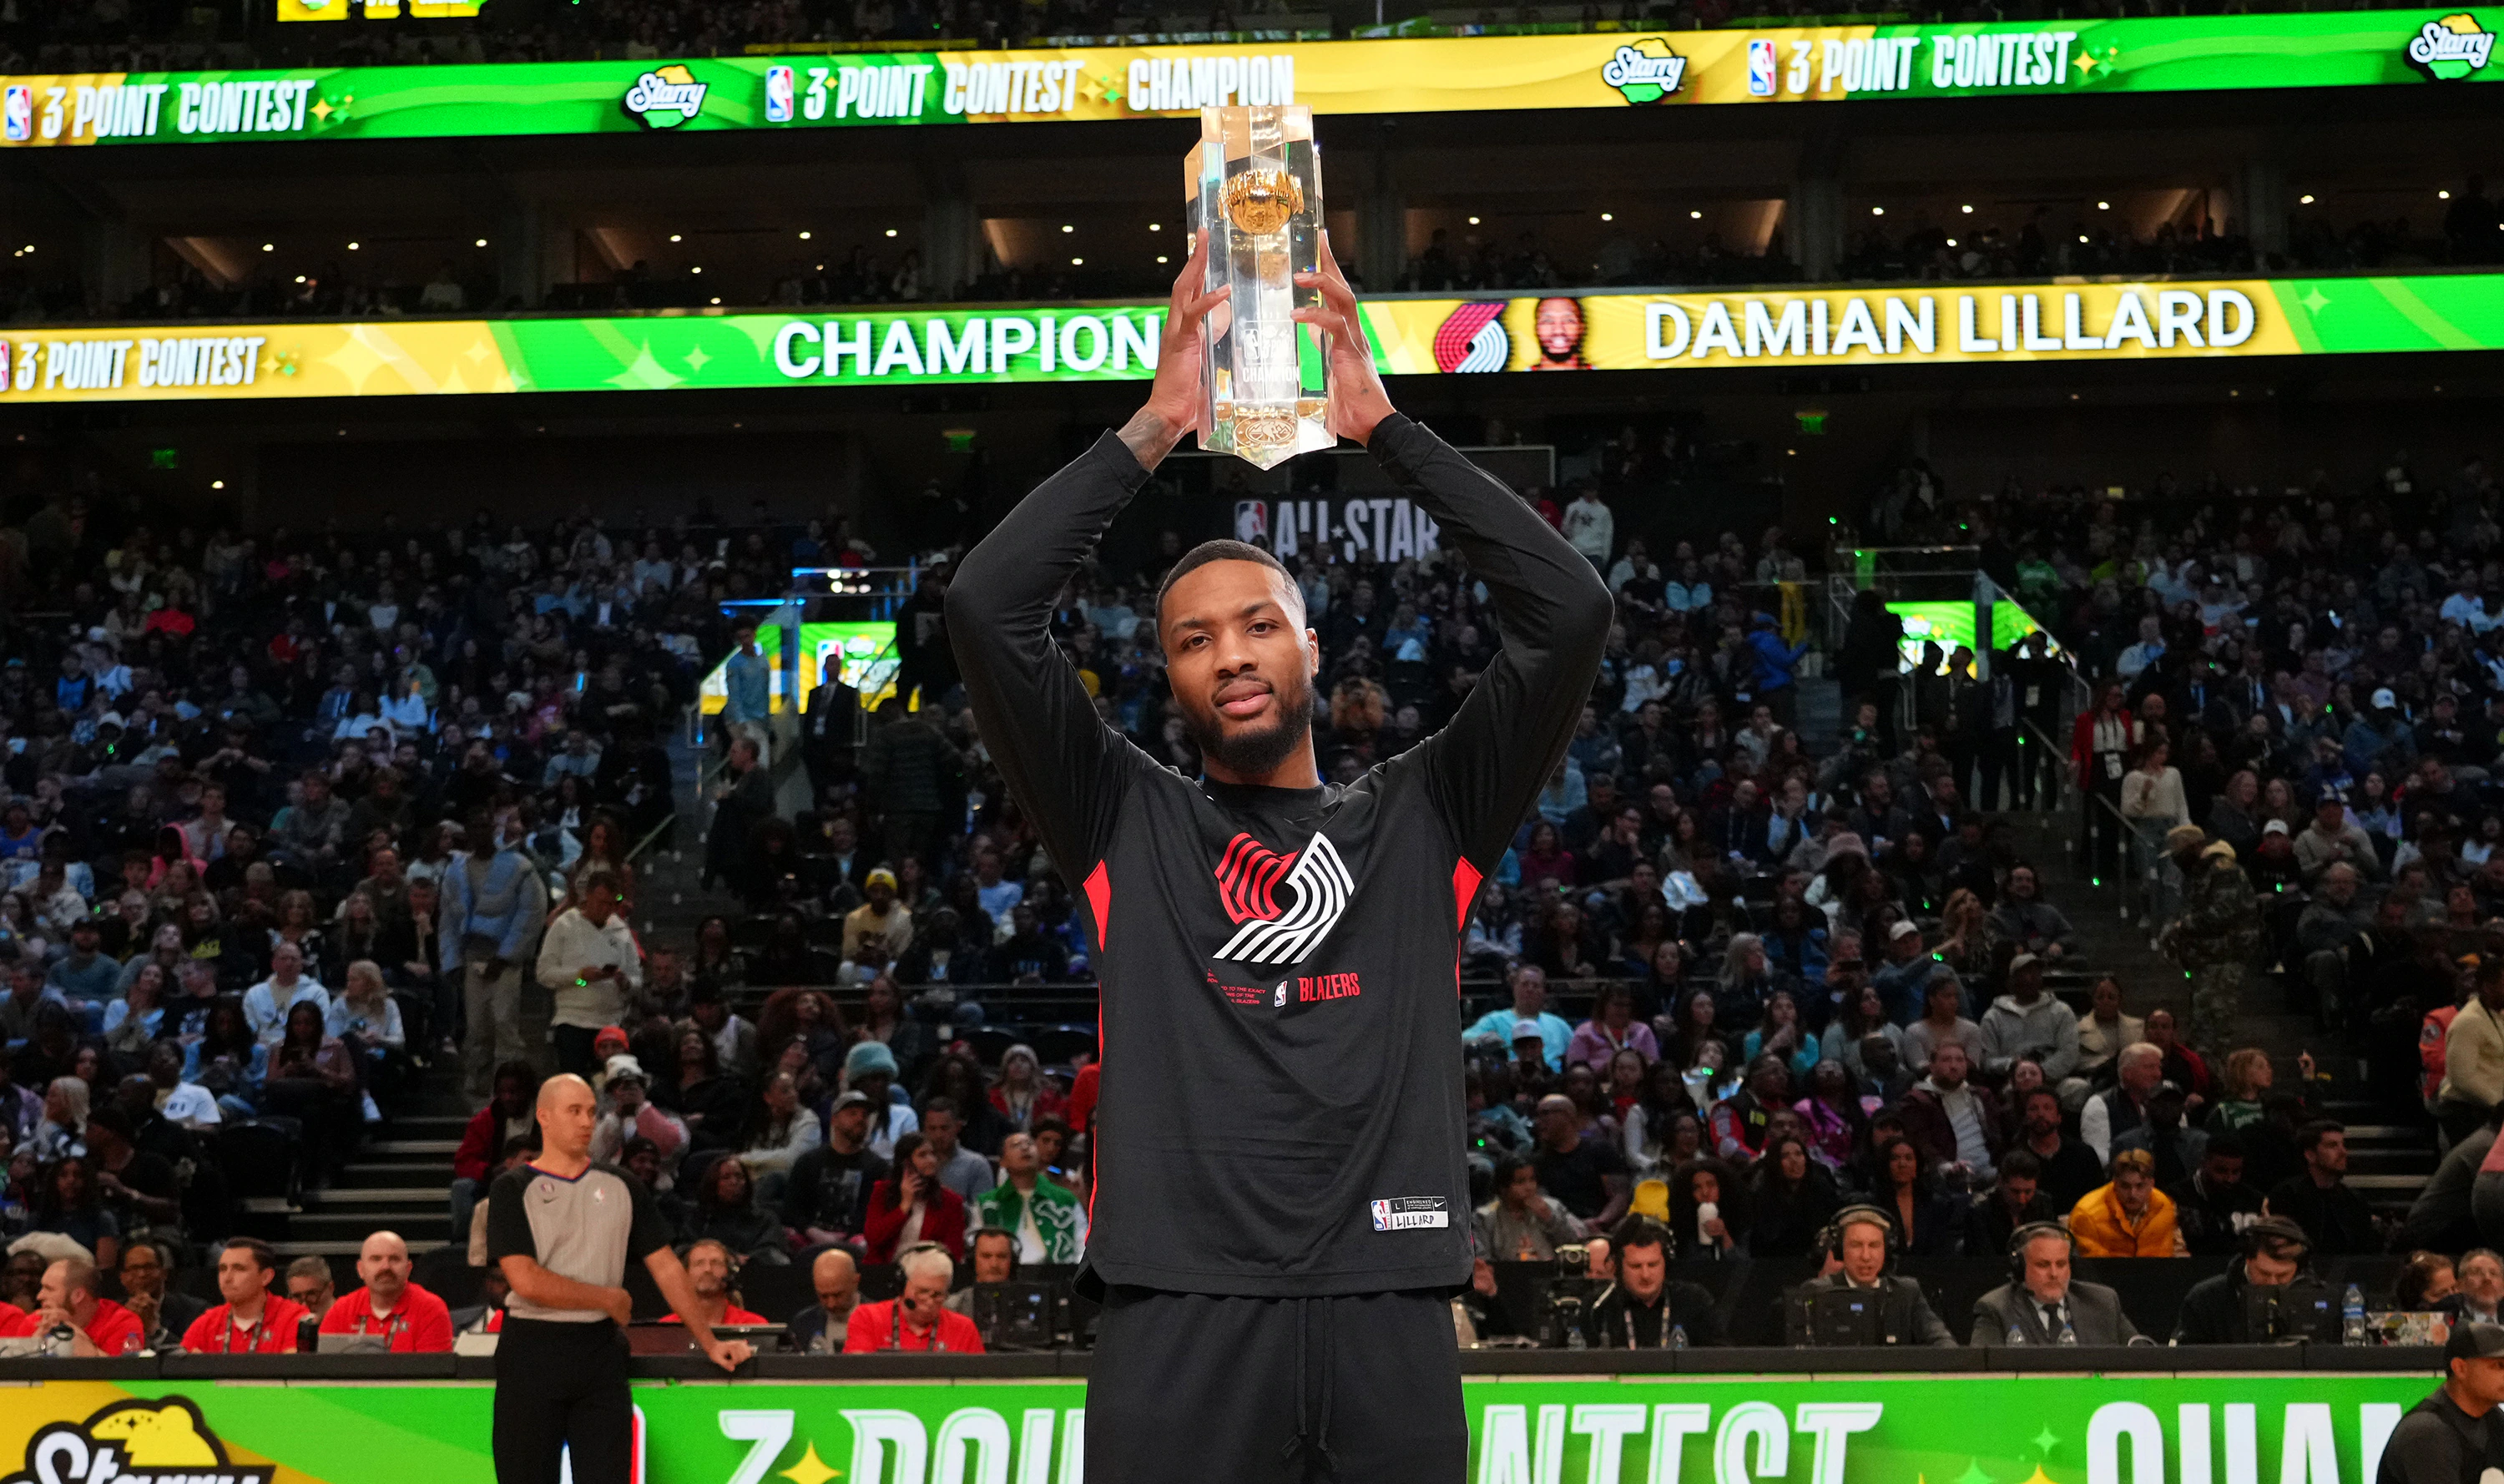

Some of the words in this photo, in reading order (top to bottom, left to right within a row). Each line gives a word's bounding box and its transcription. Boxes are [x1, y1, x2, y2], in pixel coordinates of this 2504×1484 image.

[1603, 46, 1686, 92] Starry
[1787, 40, 1812, 93] 3
[1820, 37, 1921, 93] POINT
[1931, 32, 2077, 88] CONTEST
[2409, 22, 2495, 68] Starry
[42, 87, 67, 139] 3
[72, 84, 169, 138] POINT
[177, 80, 316, 134] CONTEST
[626, 73, 708, 118] Starry
[803, 68, 829, 119] 3
[836, 64, 934, 119] POINT
[943, 60, 1085, 114] CONTEST
[1128, 55, 1294, 111] CHAMPION
[774, 315, 1161, 379] CHAMPION
[1645, 296, 1936, 360] DAMIAN
[1959, 289, 2256, 352] LILLARD
[15, 342, 39, 391] 3
[45, 341, 134, 390] POINT
[138, 337, 265, 387] CONTEST
[1242, 366, 1300, 383] CHAMPION
[1297, 972, 1361, 1002] BLAZERS
[1396, 1214, 1434, 1228] LILLARD
